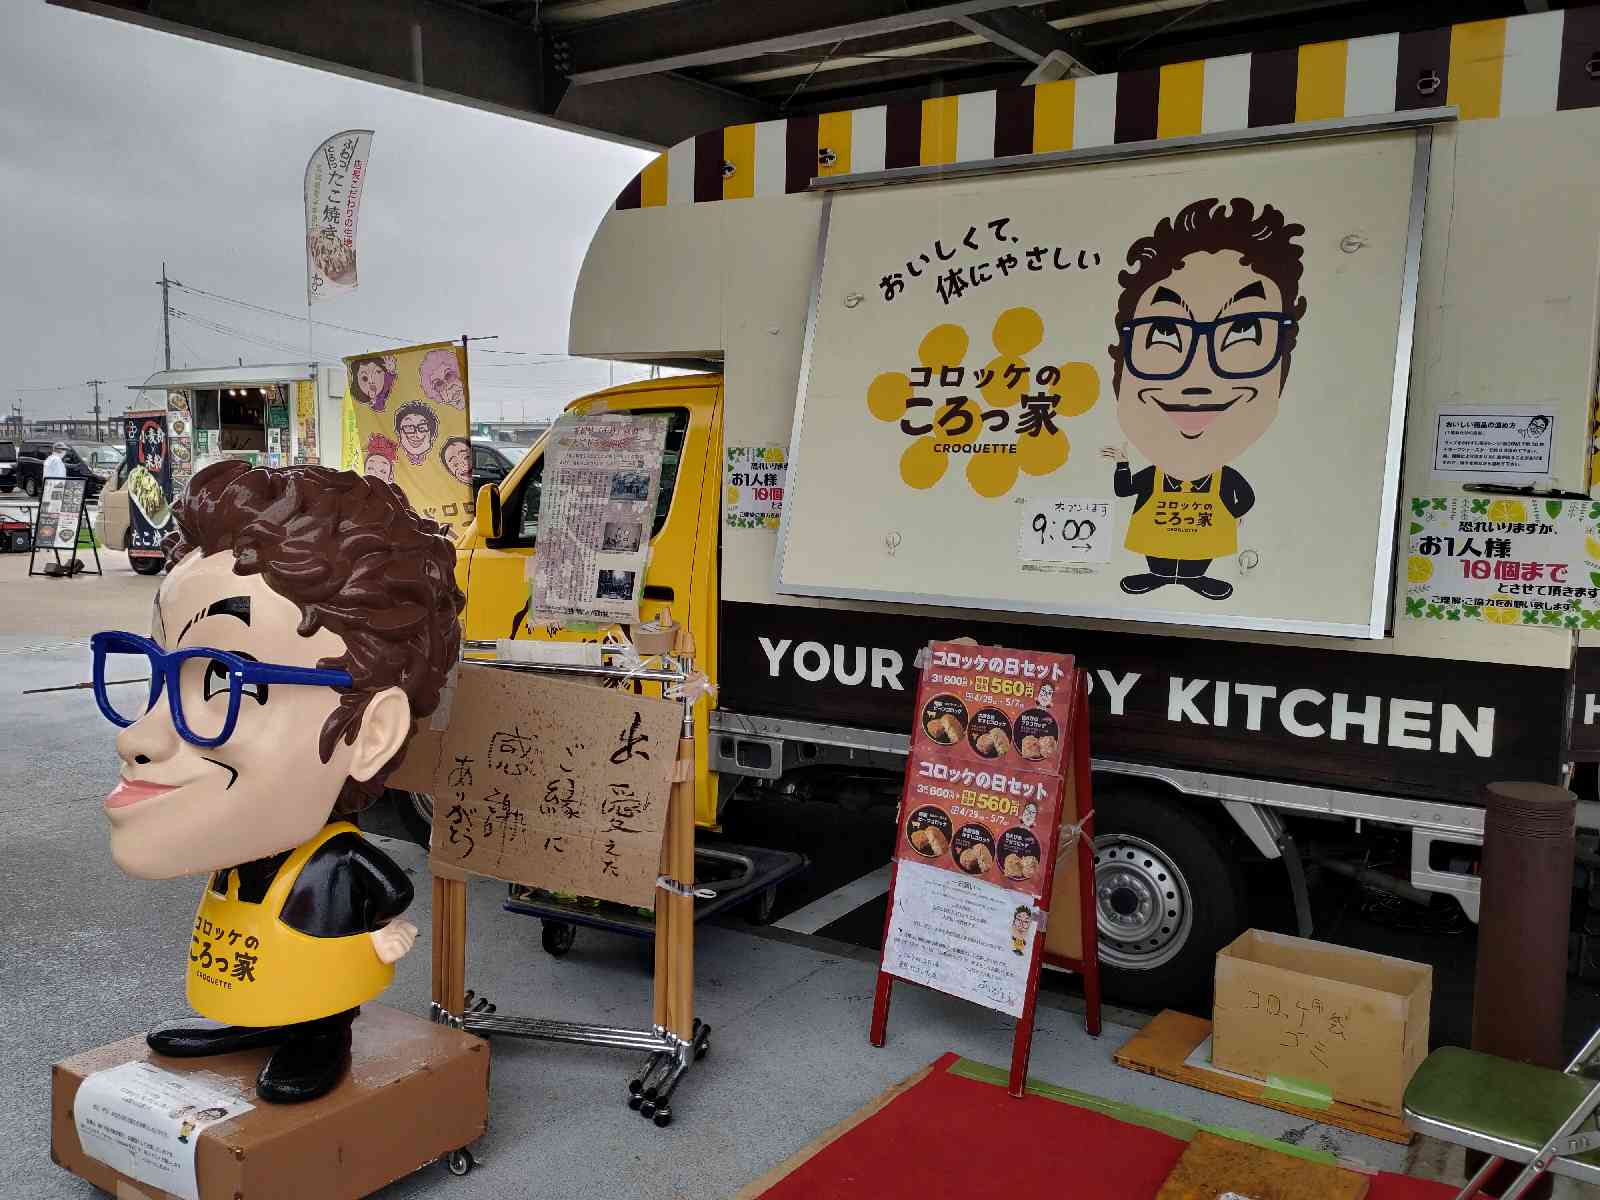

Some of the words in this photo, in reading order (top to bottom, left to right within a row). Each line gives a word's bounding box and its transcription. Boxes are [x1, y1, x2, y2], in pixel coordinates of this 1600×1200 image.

[322, 170, 345, 241] たこ焼き
[879, 217, 1019, 301] おいしくて、
[935, 246, 1101, 305] 体にやさしい
[908, 363, 1061, 390] コロッケの
[900, 391, 1062, 437] ころっ家
[933, 443, 1017, 454] CROQUETTE
[732, 473, 778, 486] お1人様
[1154, 511, 1213, 528] ころっ家
[1156, 501, 1213, 511] コロッケの
[1419, 535, 1512, 559] お1人様
[1460, 559, 1569, 583] 10個まで
[932, 651, 1065, 681] コロッケの日セット
[758, 636, 905, 691] YOUR
[1167, 676, 1496, 758] KITCHEN
[918, 761, 1049, 801] コロッケの日セット
